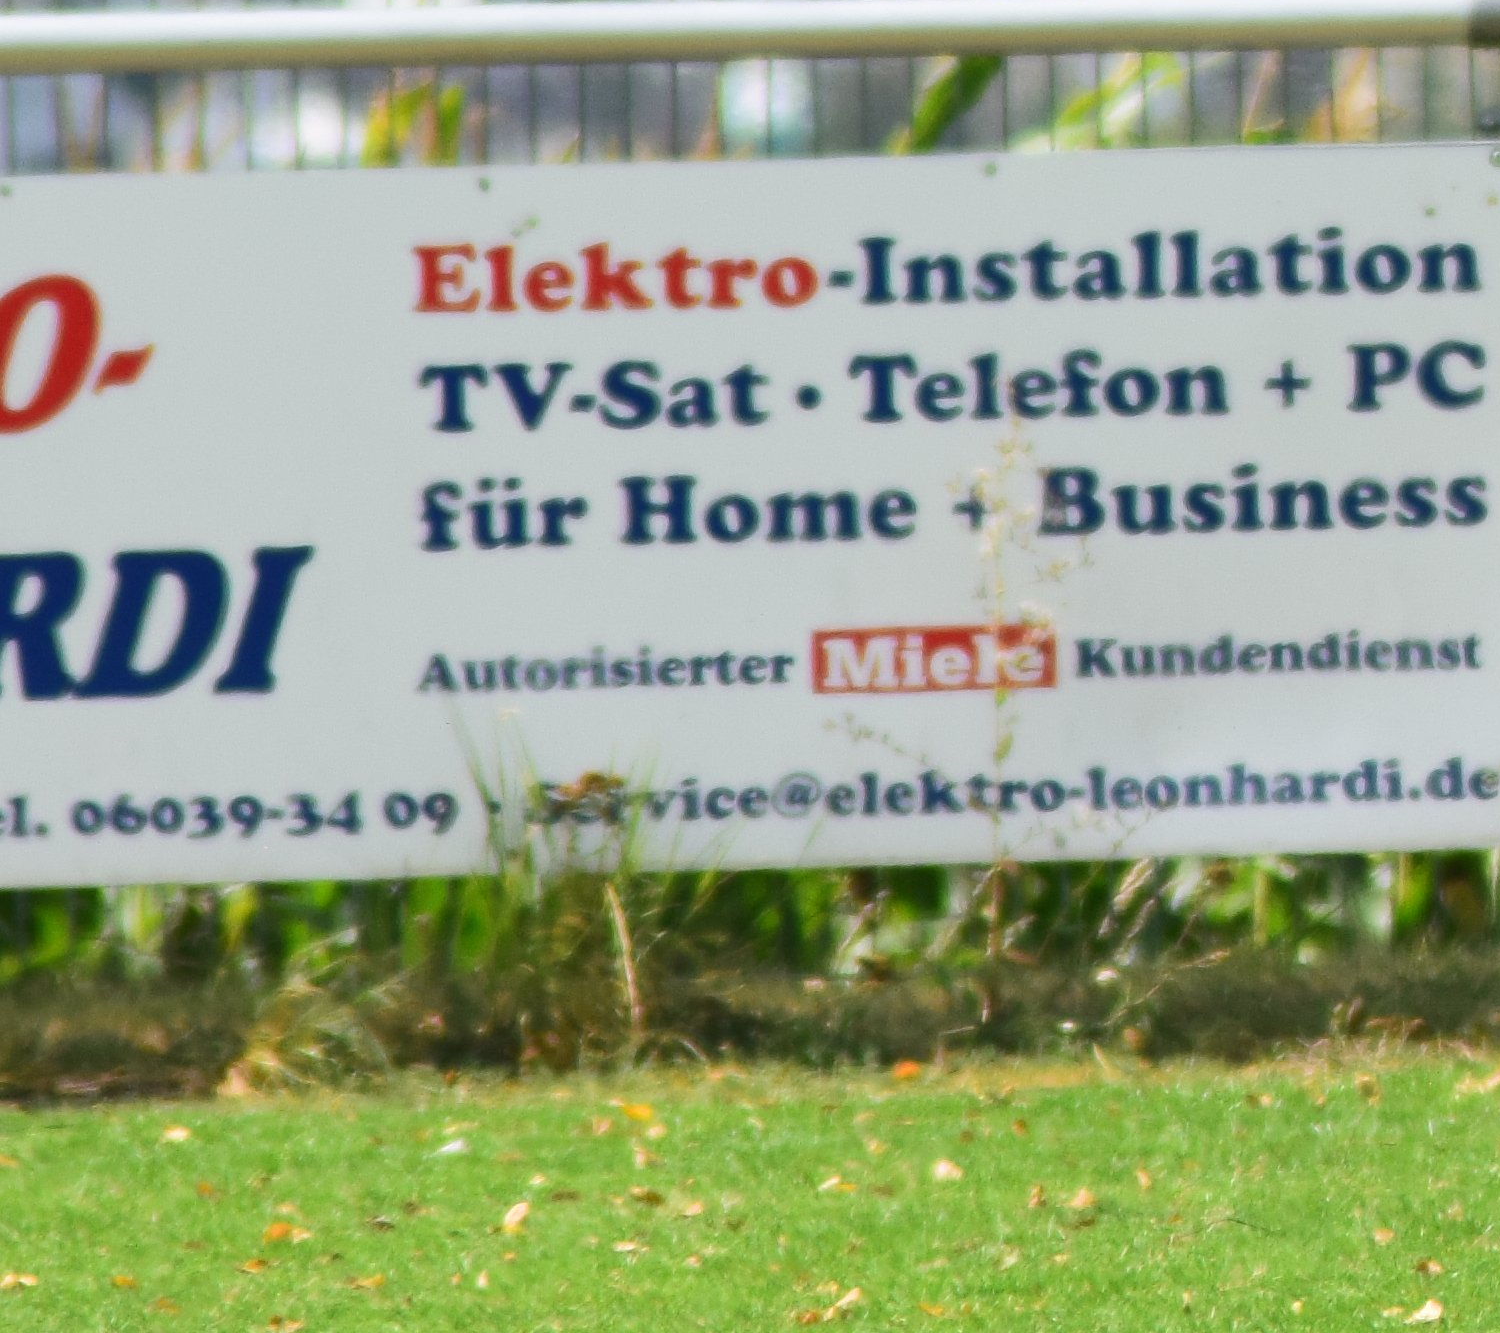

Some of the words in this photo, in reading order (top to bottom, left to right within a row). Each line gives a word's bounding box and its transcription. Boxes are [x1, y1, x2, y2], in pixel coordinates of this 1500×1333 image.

[413, 227, 1483, 315] Elektro-Installation
[420, 359, 771, 433] TV-Sat
[848, 349, 1230, 424] Telefon
[1347, 340, 1487, 413] PC
[420, 476, 589, 552] für
[619, 474, 918, 545] Home
[1038, 463, 1489, 536] Business
[417, 647, 794, 693] Autorisierter
[823, 633, 1045, 688] Miele
[1074, 630, 1483, 679] Kundendienst
[0, 792, 51, 837] l.
[72, 790, 363, 839] 06039-34
[383, 790, 459, 836] 09
